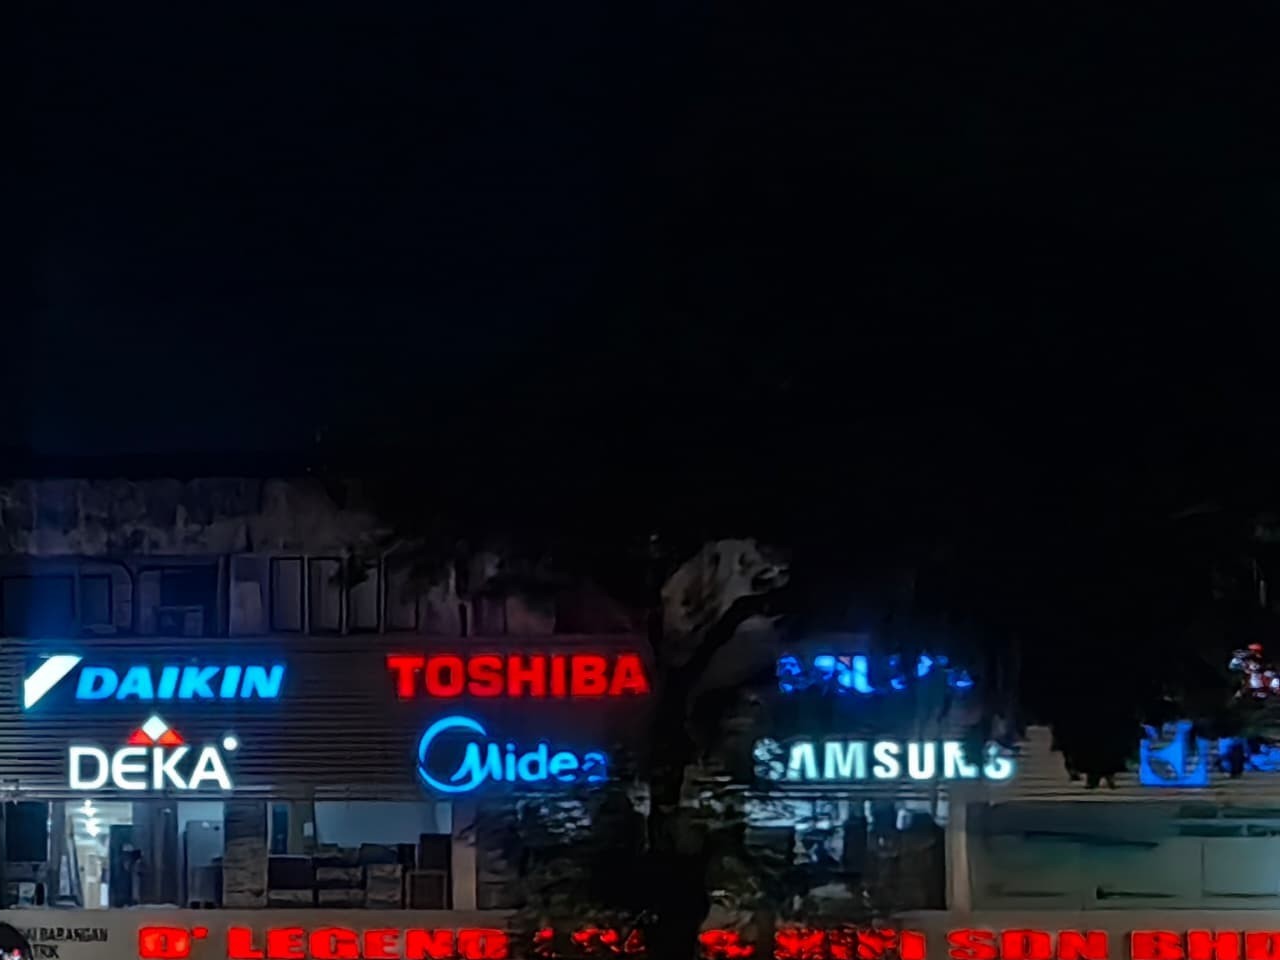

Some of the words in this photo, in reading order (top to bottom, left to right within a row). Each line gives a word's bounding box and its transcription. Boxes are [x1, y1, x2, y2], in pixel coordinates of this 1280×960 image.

[75, 664, 286, 699] DAIKIN
[385, 655, 650, 697] TOSHIBA
[69, 747, 233, 790] DEKA
